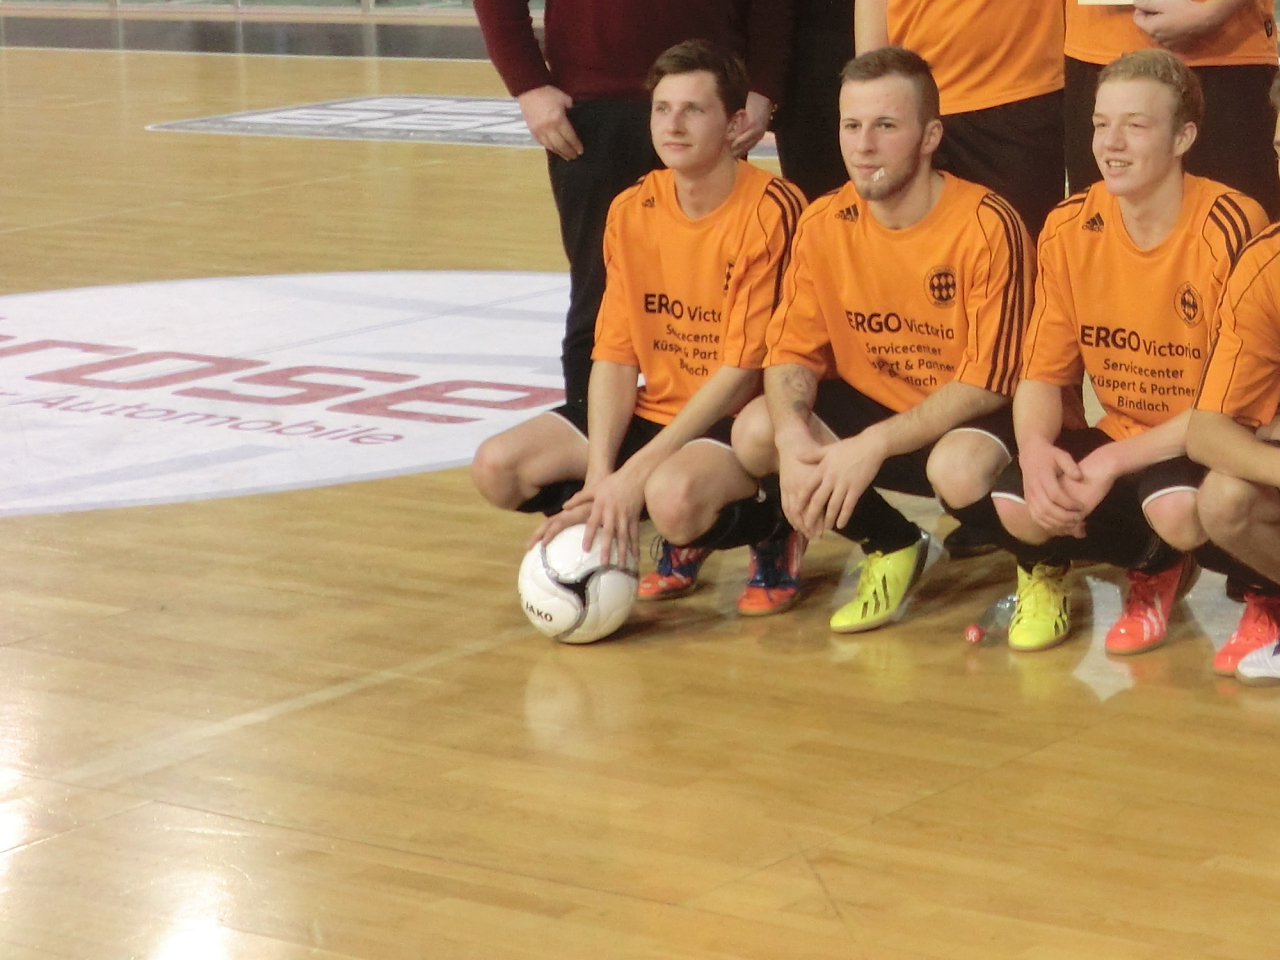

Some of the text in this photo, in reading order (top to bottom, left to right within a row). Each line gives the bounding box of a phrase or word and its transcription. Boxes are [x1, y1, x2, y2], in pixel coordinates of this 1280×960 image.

[845, 309, 902, 333] ERGO
[865, 342, 942, 355] Servicecenter
[1080, 325, 1201, 359] ERGO Victoria
[904, 359, 914, 371] &
[1103, 358, 1185, 379] Servicecenter
[1090, 374, 1196, 397] Küspert & Partner
[1117, 395, 1170, 412] Bindlach
[8, 394, 404, 445] Automobile
